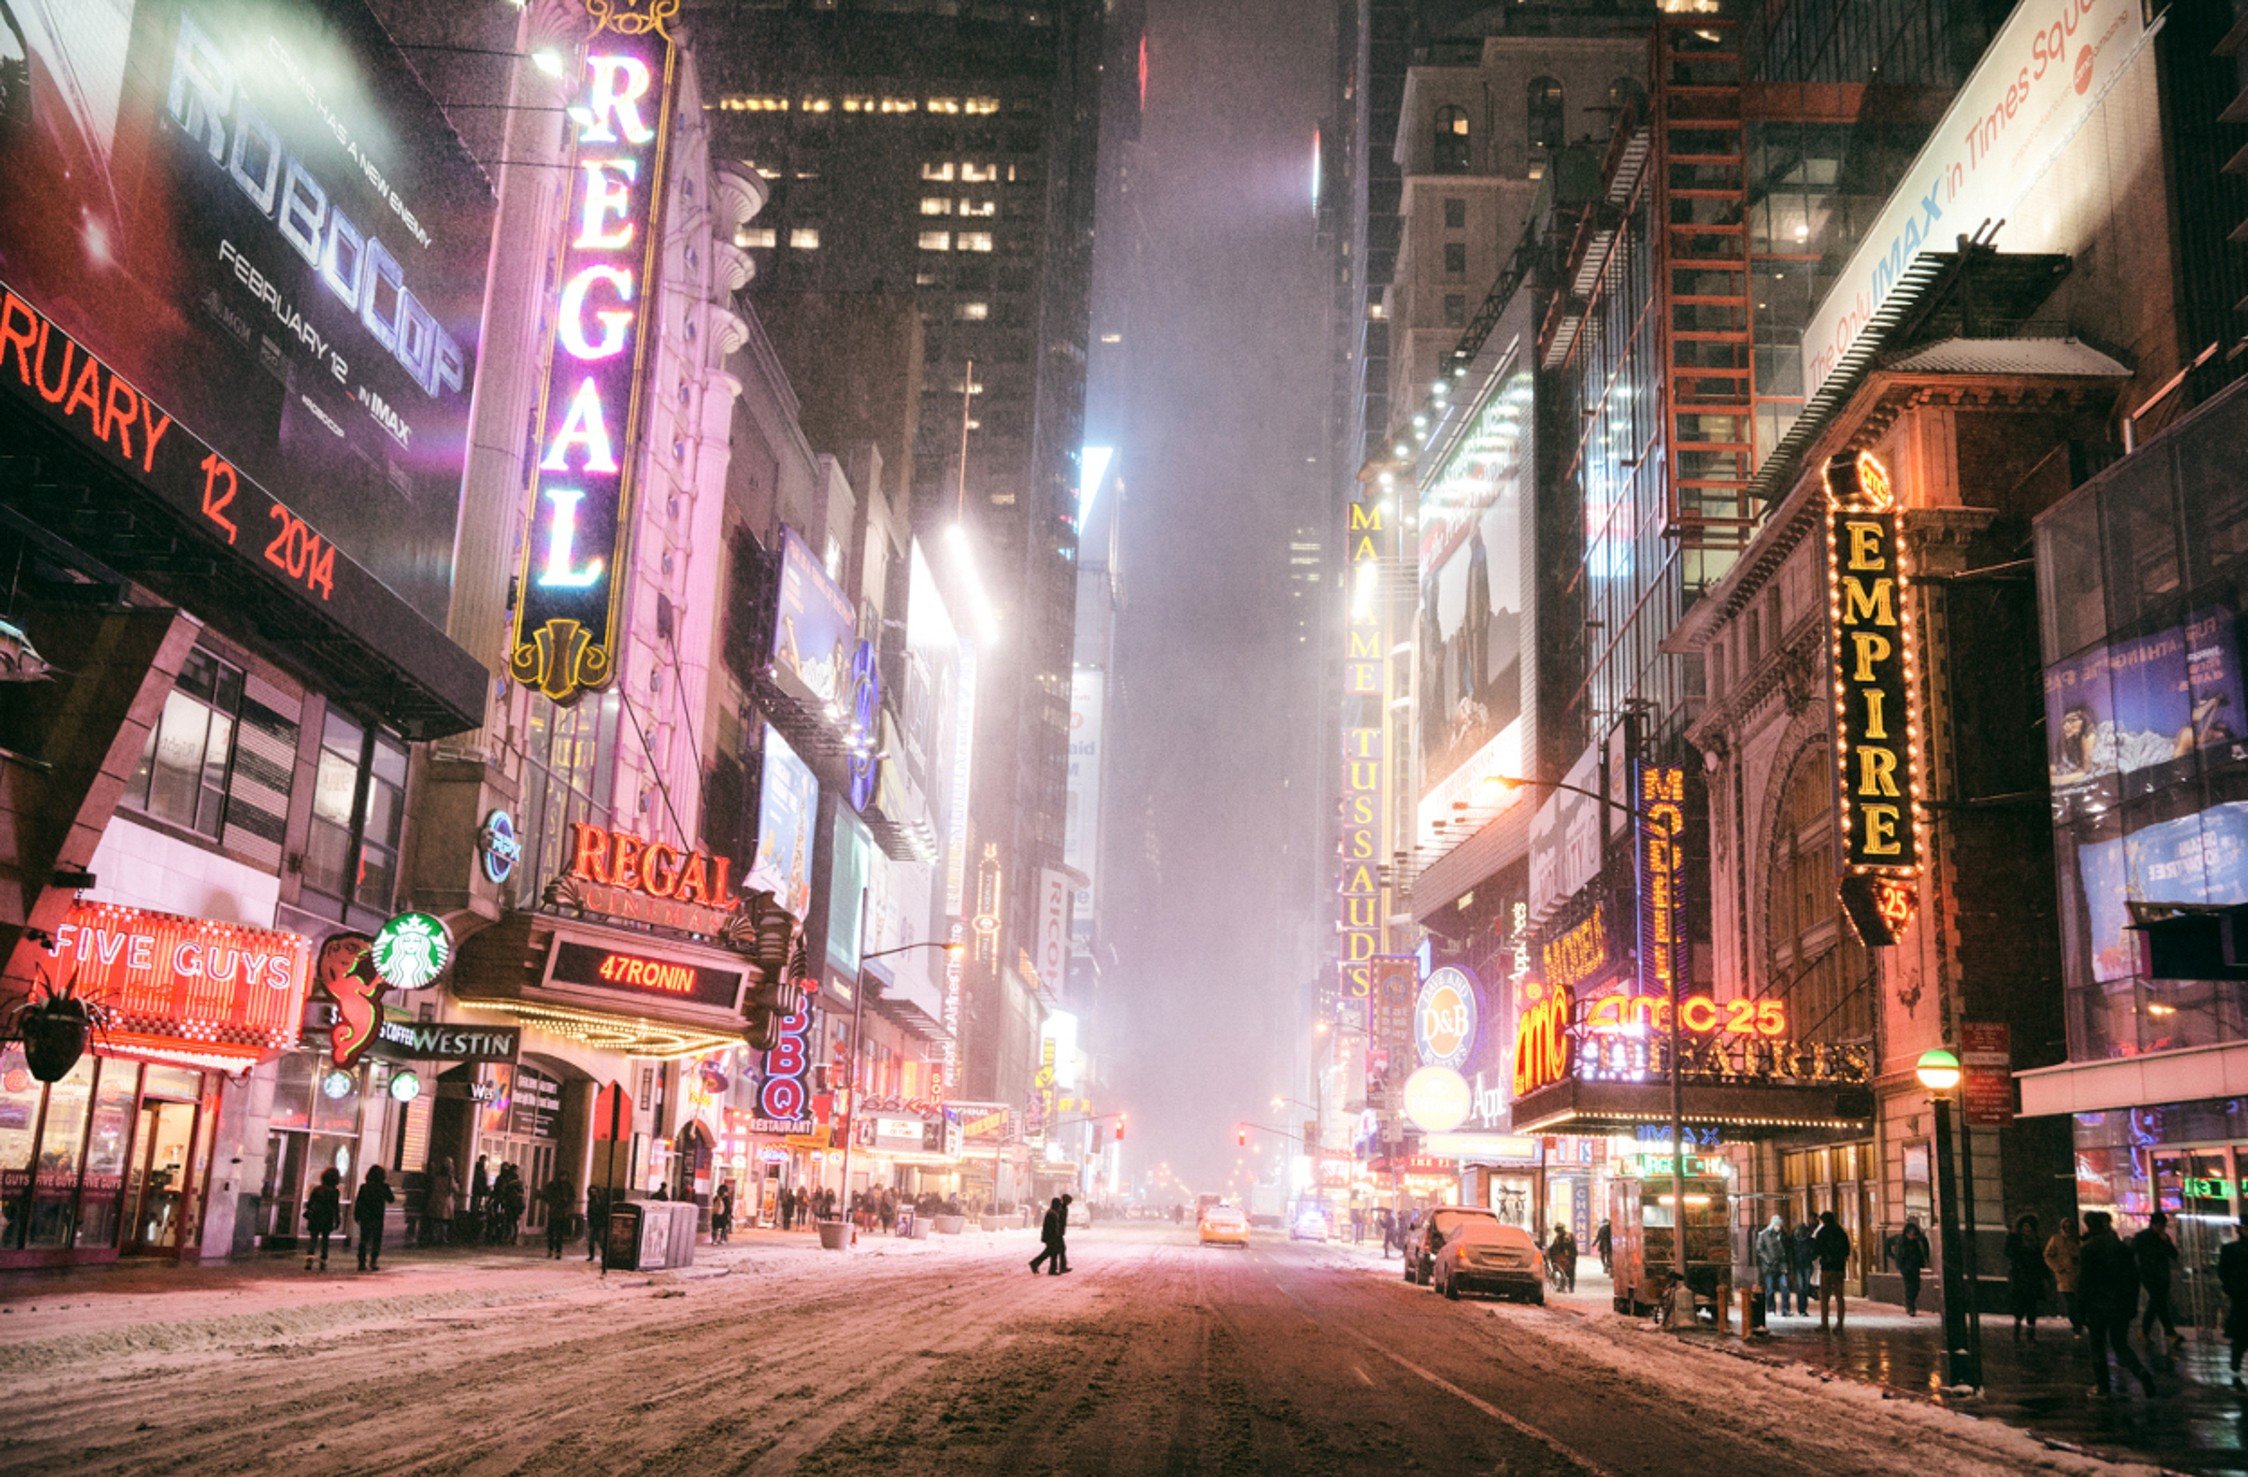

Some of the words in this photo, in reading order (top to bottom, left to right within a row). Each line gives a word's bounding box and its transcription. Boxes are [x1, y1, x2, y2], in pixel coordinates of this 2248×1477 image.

[316, 99, 348, 146] HAS
[347, 141, 358, 163] A
[359, 153, 390, 198] NEW
[389, 190, 432, 250] ENEMY
[1871, 177, 1943, 308] IMAX
[1946, 163, 1964, 204] in
[1965, 67, 2030, 173] Times
[168, 10, 465, 399] ROBOCOP
[218, 239, 328, 360] FEBRUARY
[331, 350, 349, 385] 12
[540, 55, 654, 588] REGAL
[370, 392, 413, 446] IMAX
[264, 503, 335, 601] 2014
[1842, 520, 1902, 857] EMPIRE
[571, 821, 741, 913] REGAL
[586, 890, 724, 936] CINEMAS
[1883, 887, 1908, 920] 25
[47, 923, 155, 971] FIVE
[173, 940, 292, 991] GUYS
[386, 1022, 415, 1047] COFFEE
[411, 1027, 514, 1056] WESTIN
[1421, 1004, 1470, 1042] D&B
[1725, 1000, 1786, 1036] 25
[1637, 1124, 1720, 1146] IMAX
[5, 1174, 31, 1186] GUYS
[55, 1176, 79, 1189] GUYS
[101, 1178, 123, 1191] GUYS
